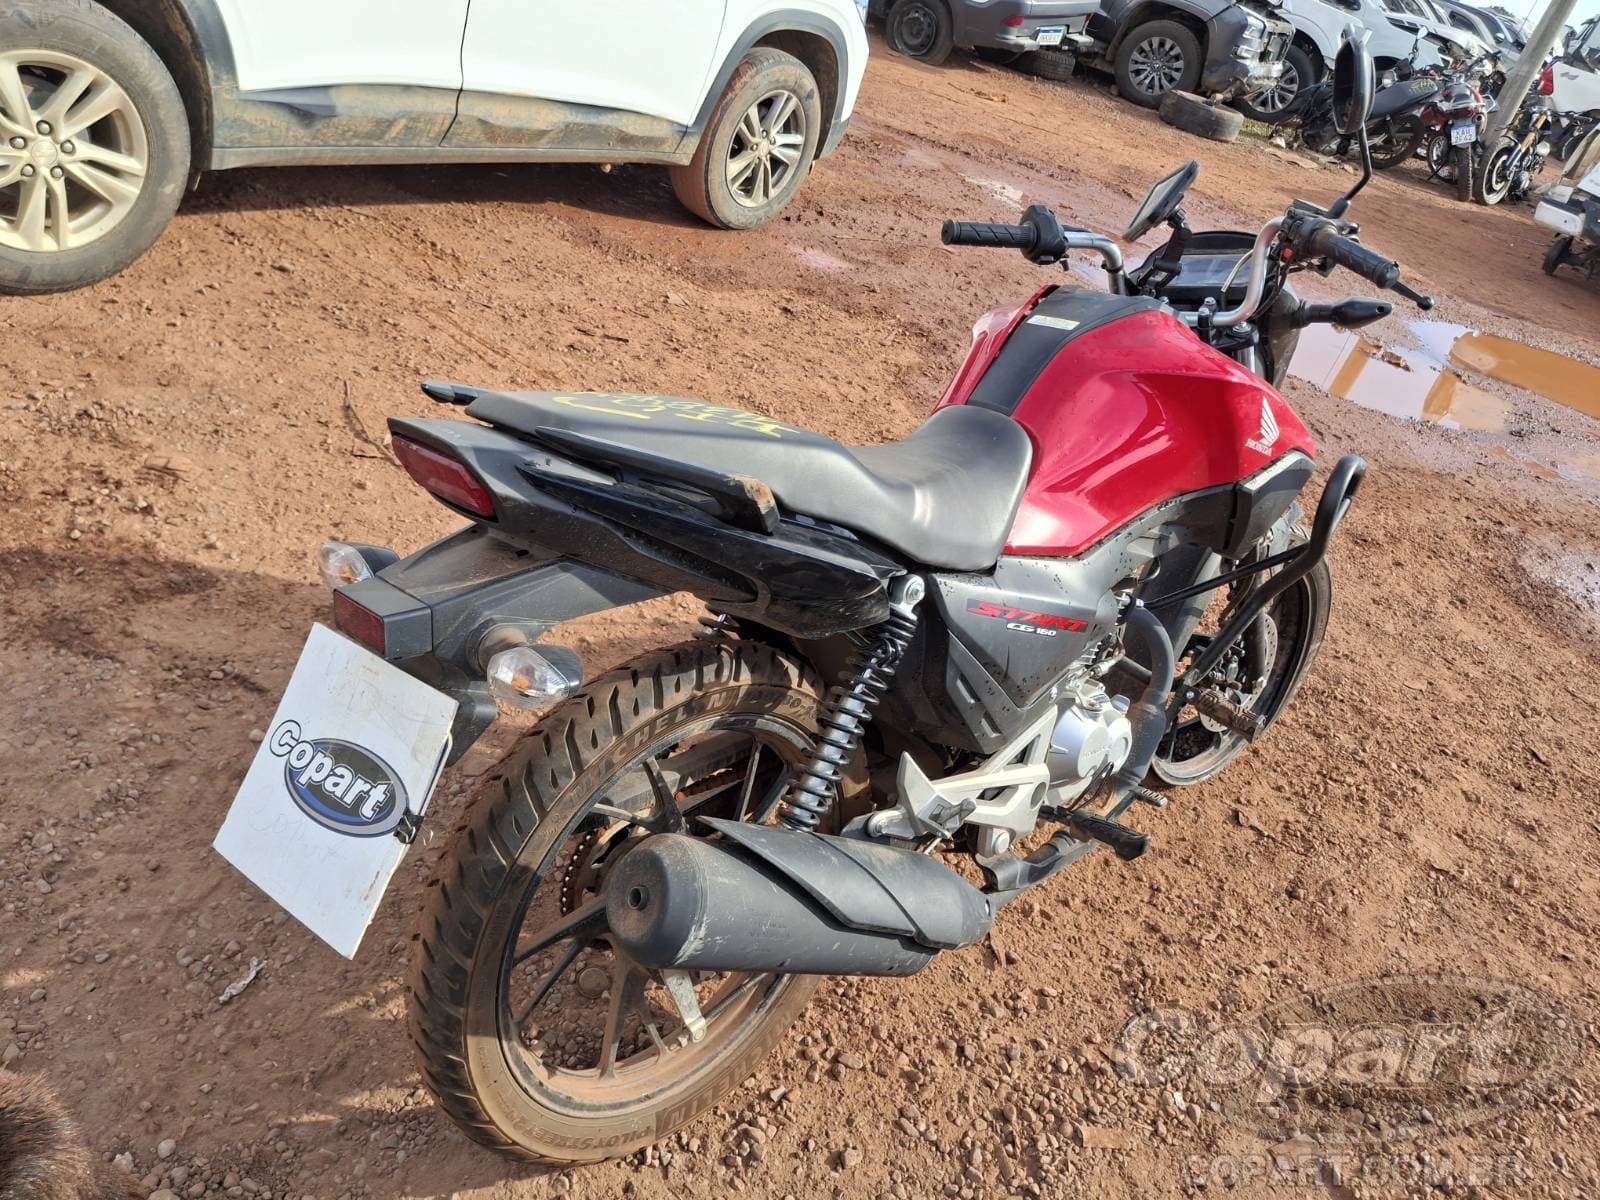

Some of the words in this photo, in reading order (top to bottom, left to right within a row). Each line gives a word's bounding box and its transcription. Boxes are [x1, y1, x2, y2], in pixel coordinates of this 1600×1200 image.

[1244, 438, 1273, 457] HONDA
[966, 601, 1089, 633] START
[1006, 622, 1035, 633] CG
[1036, 627, 1057, 638] 160
[269, 719, 394, 822] Copart
